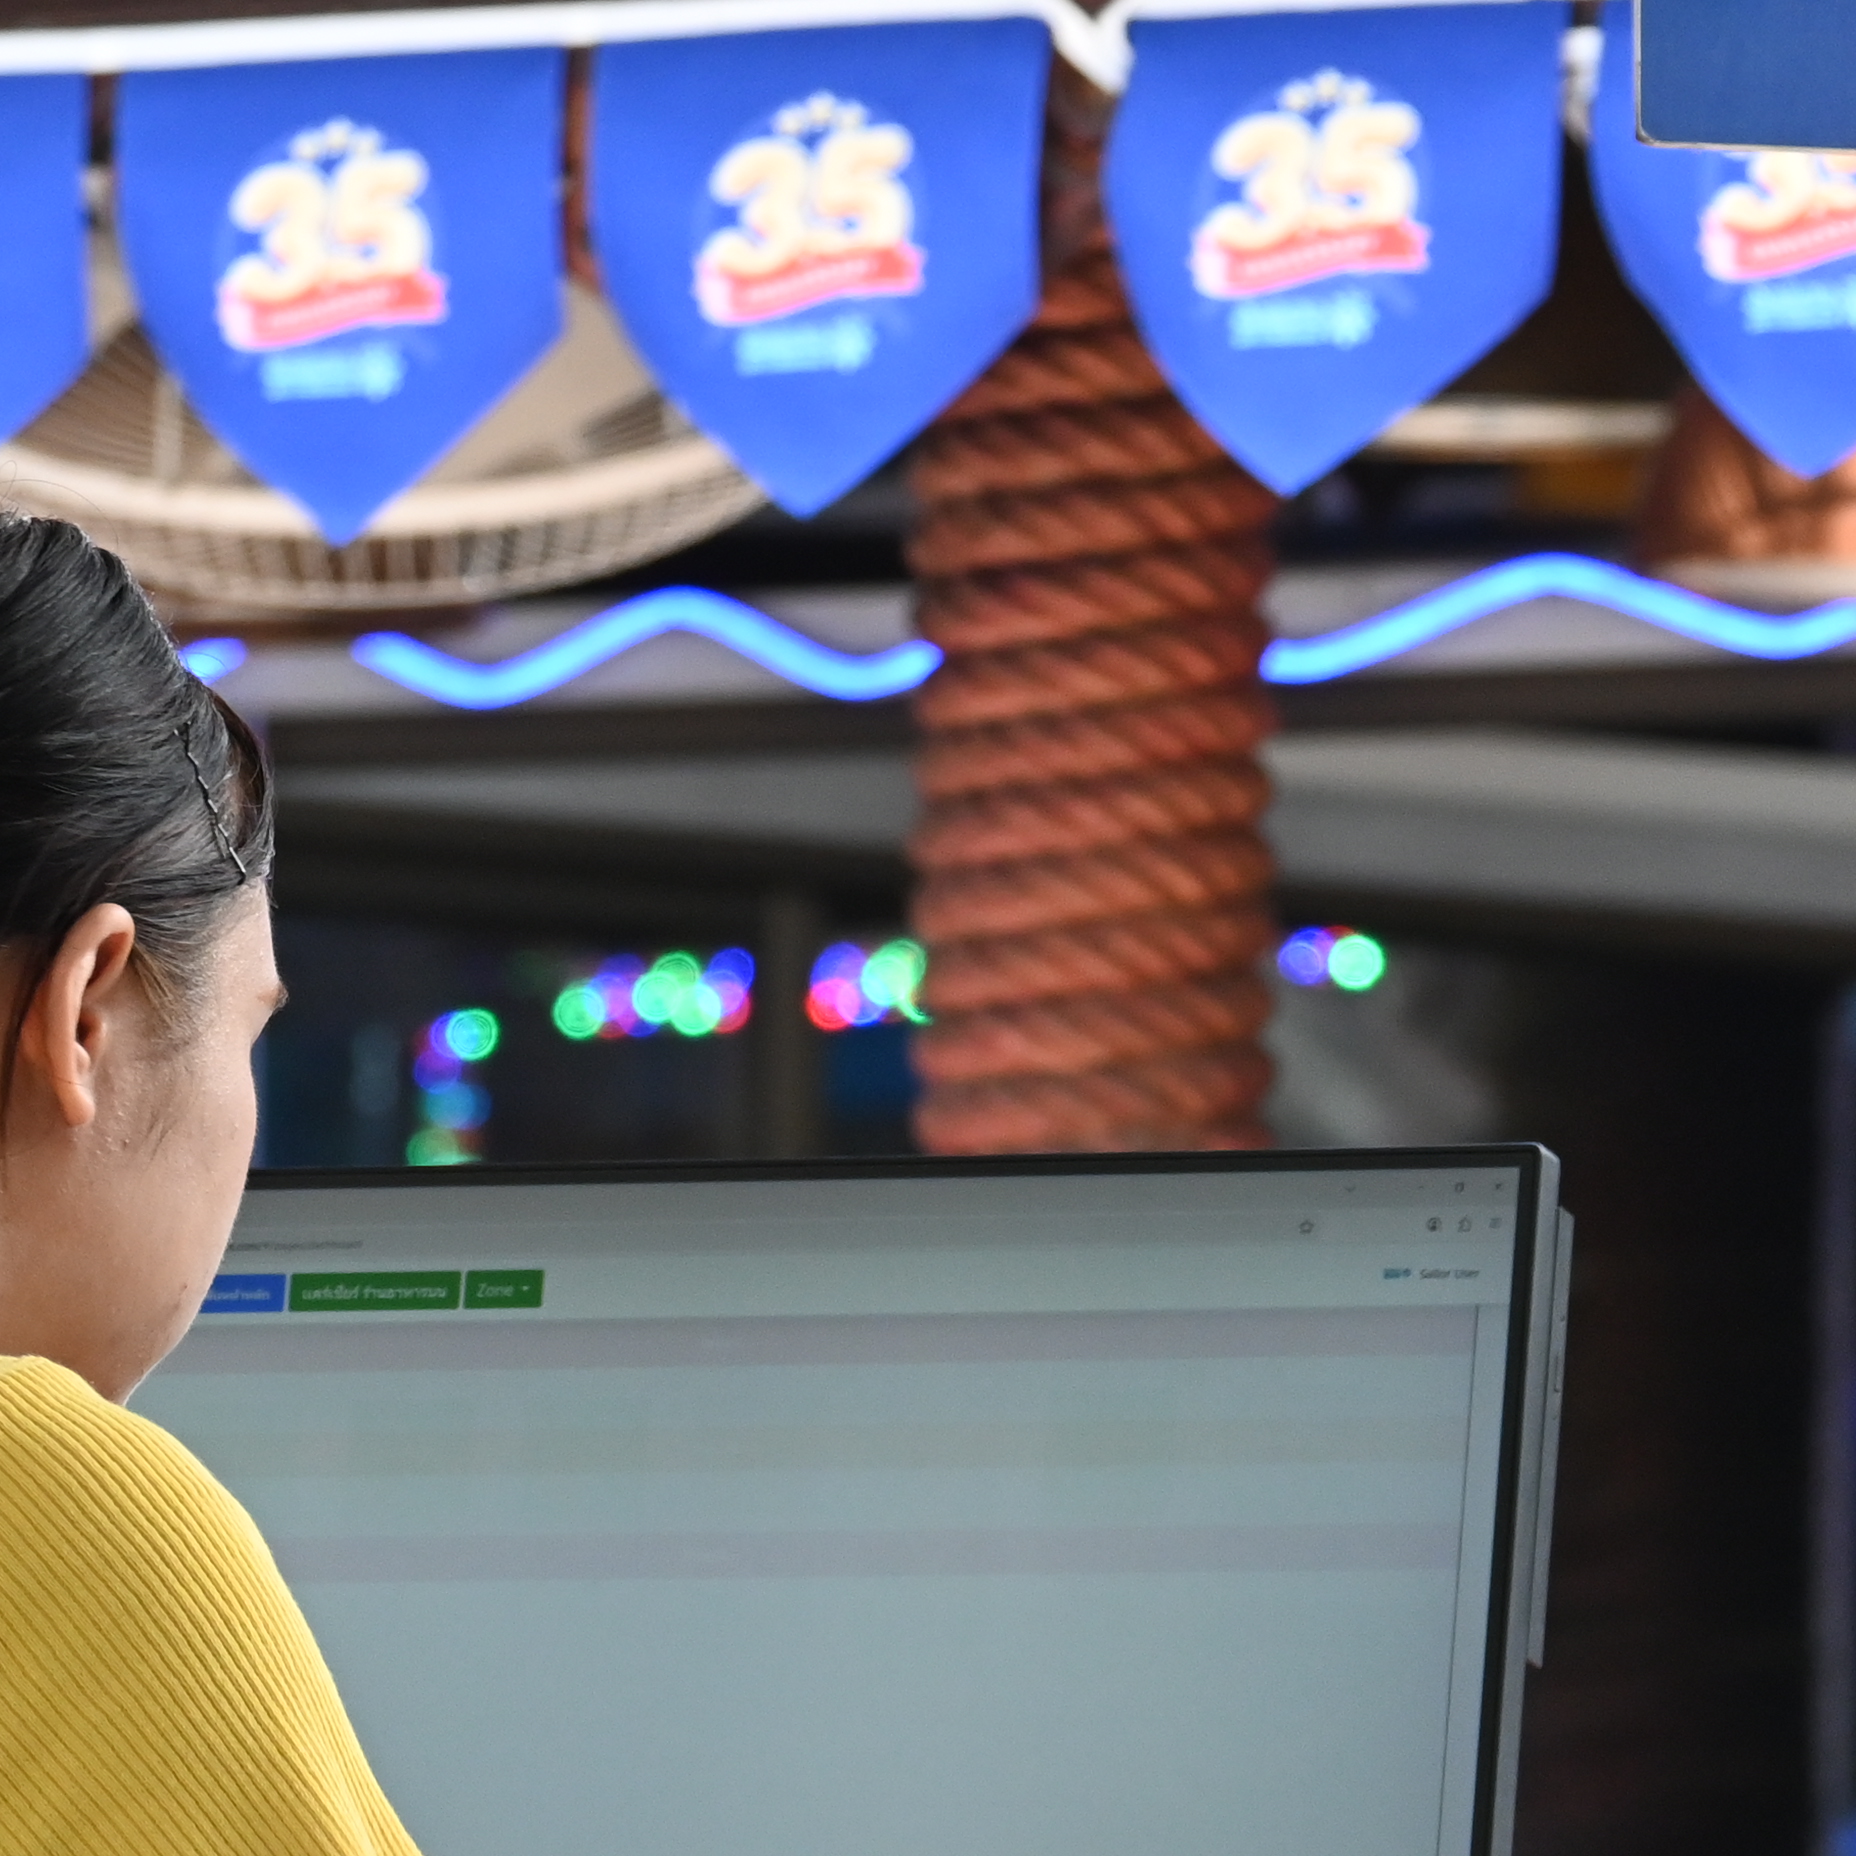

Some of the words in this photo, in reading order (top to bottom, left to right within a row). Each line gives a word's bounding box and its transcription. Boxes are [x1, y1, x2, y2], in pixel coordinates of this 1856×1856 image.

[221, 149, 431, 302] 35
[699, 123, 915, 278] 35
[1202, 98, 1423, 250] 35
[477, 1283, 514, 1298] Zone
